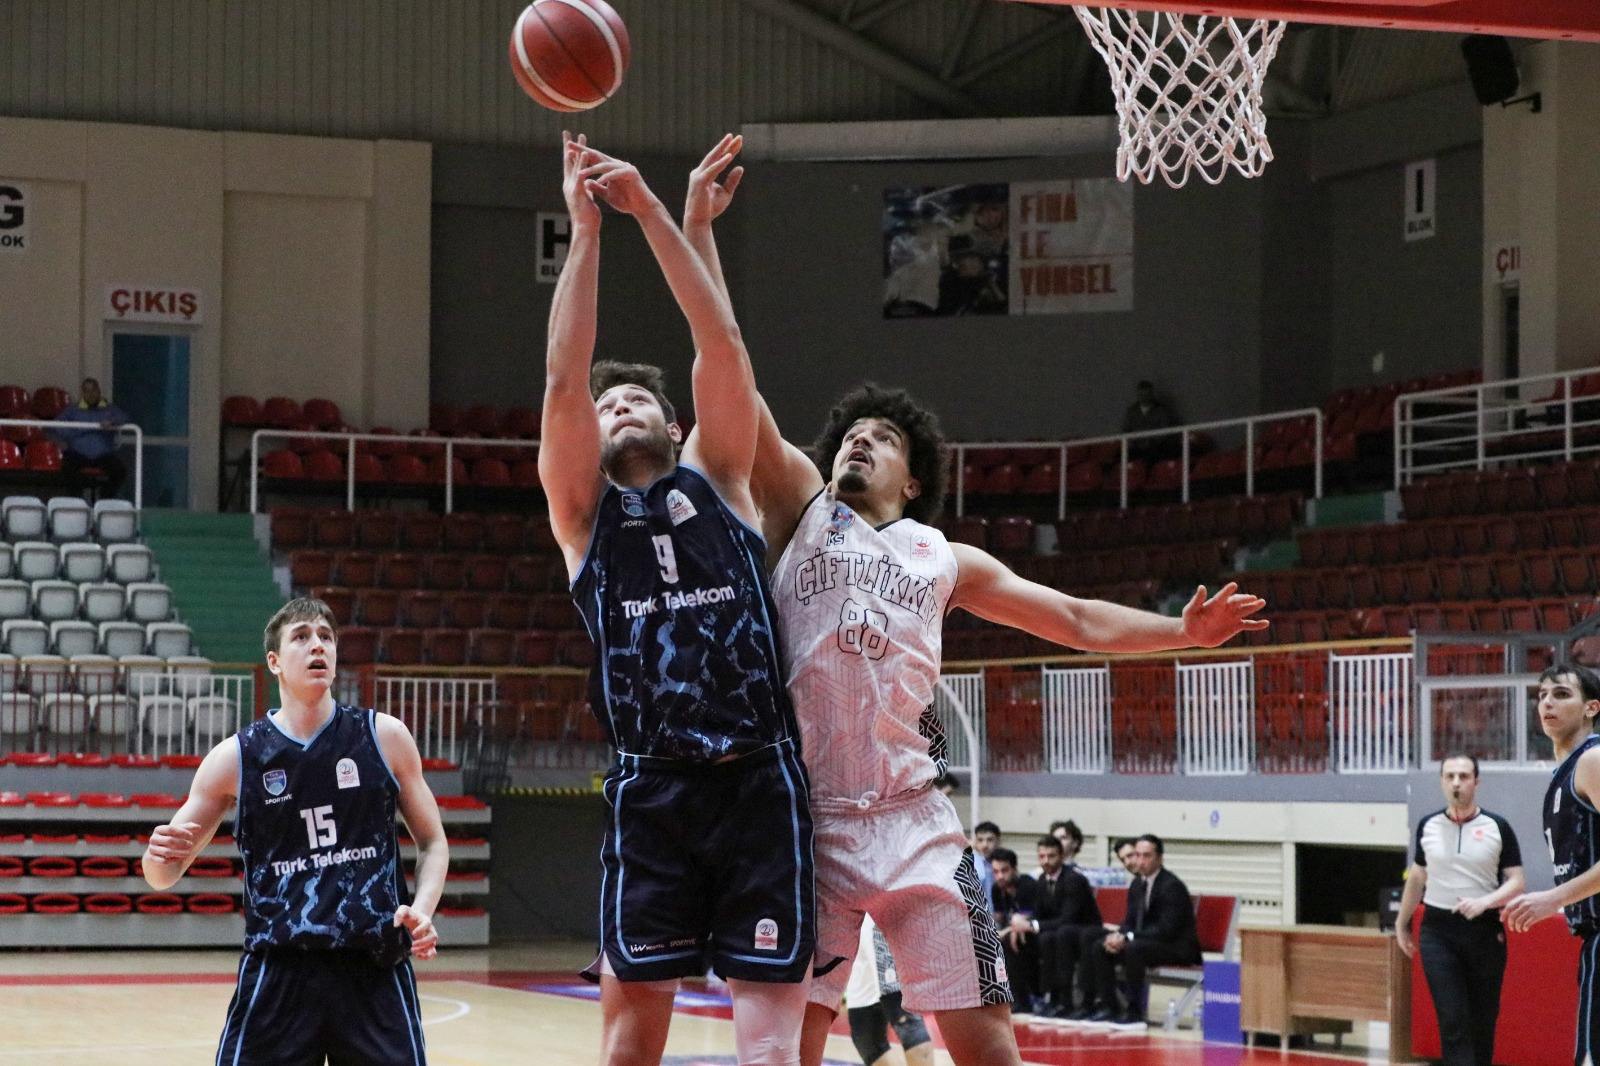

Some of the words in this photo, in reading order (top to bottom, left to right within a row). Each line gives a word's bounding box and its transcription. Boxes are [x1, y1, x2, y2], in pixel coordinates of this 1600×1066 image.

[0, 185, 24, 229] G
[0, 235, 24, 247] OK
[543, 219, 572, 259] H
[541, 265, 563, 276] BL
[111, 289, 198, 320] ÇIKIŞ
[652, 534, 679, 584] 9
[622, 595, 659, 619] Türk
[661, 585, 736, 610] Telekom
[838, 598, 890, 661] 88
[300, 804, 338, 850] 15
[271, 857, 308, 876] Türk
[310, 846, 377, 869] Telekom
